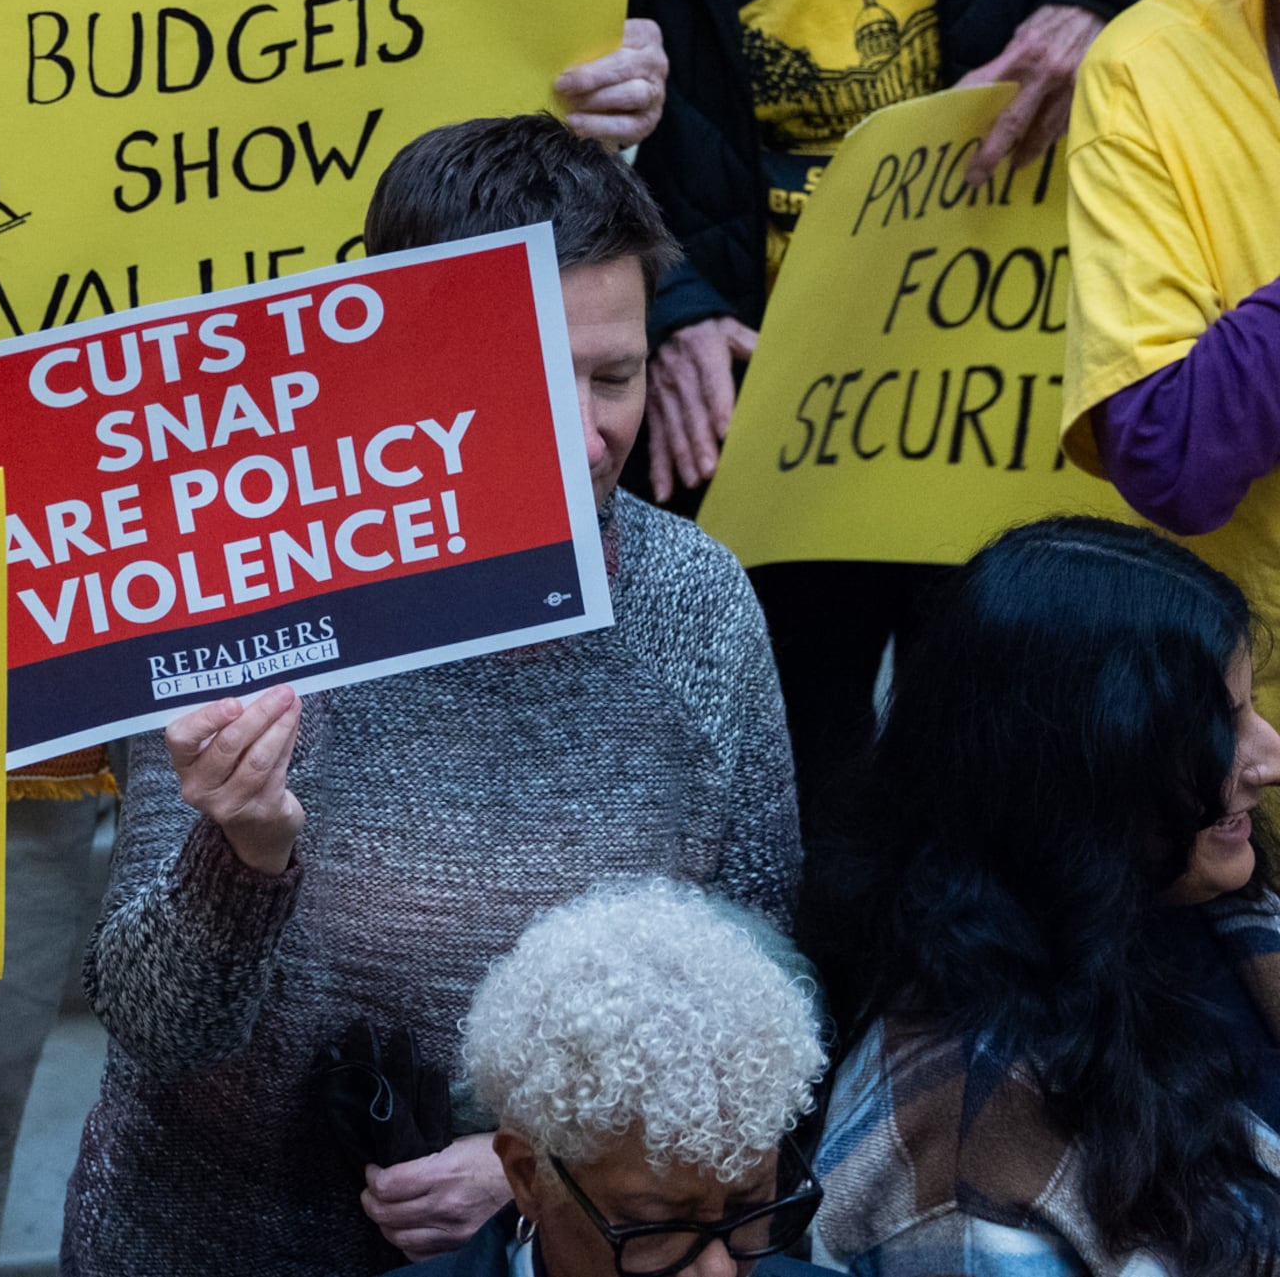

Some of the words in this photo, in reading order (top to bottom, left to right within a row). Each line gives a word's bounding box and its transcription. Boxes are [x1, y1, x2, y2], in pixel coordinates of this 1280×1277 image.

[113, 109, 385, 214] SHOW
[28, 312, 246, 409] CUTS
[267, 283, 385, 356] TO
[95, 370, 320, 473] SNAP
[6, 484, 148, 571] ARE
[169, 409, 477, 536] POLICY
[16, 490, 467, 646] VIOLENCE!
[147, 615, 335, 680] REPAIRERS
[157, 679, 183, 696] OF
[190, 670, 235, 690] THE
[257, 643, 335, 676] BREACH
